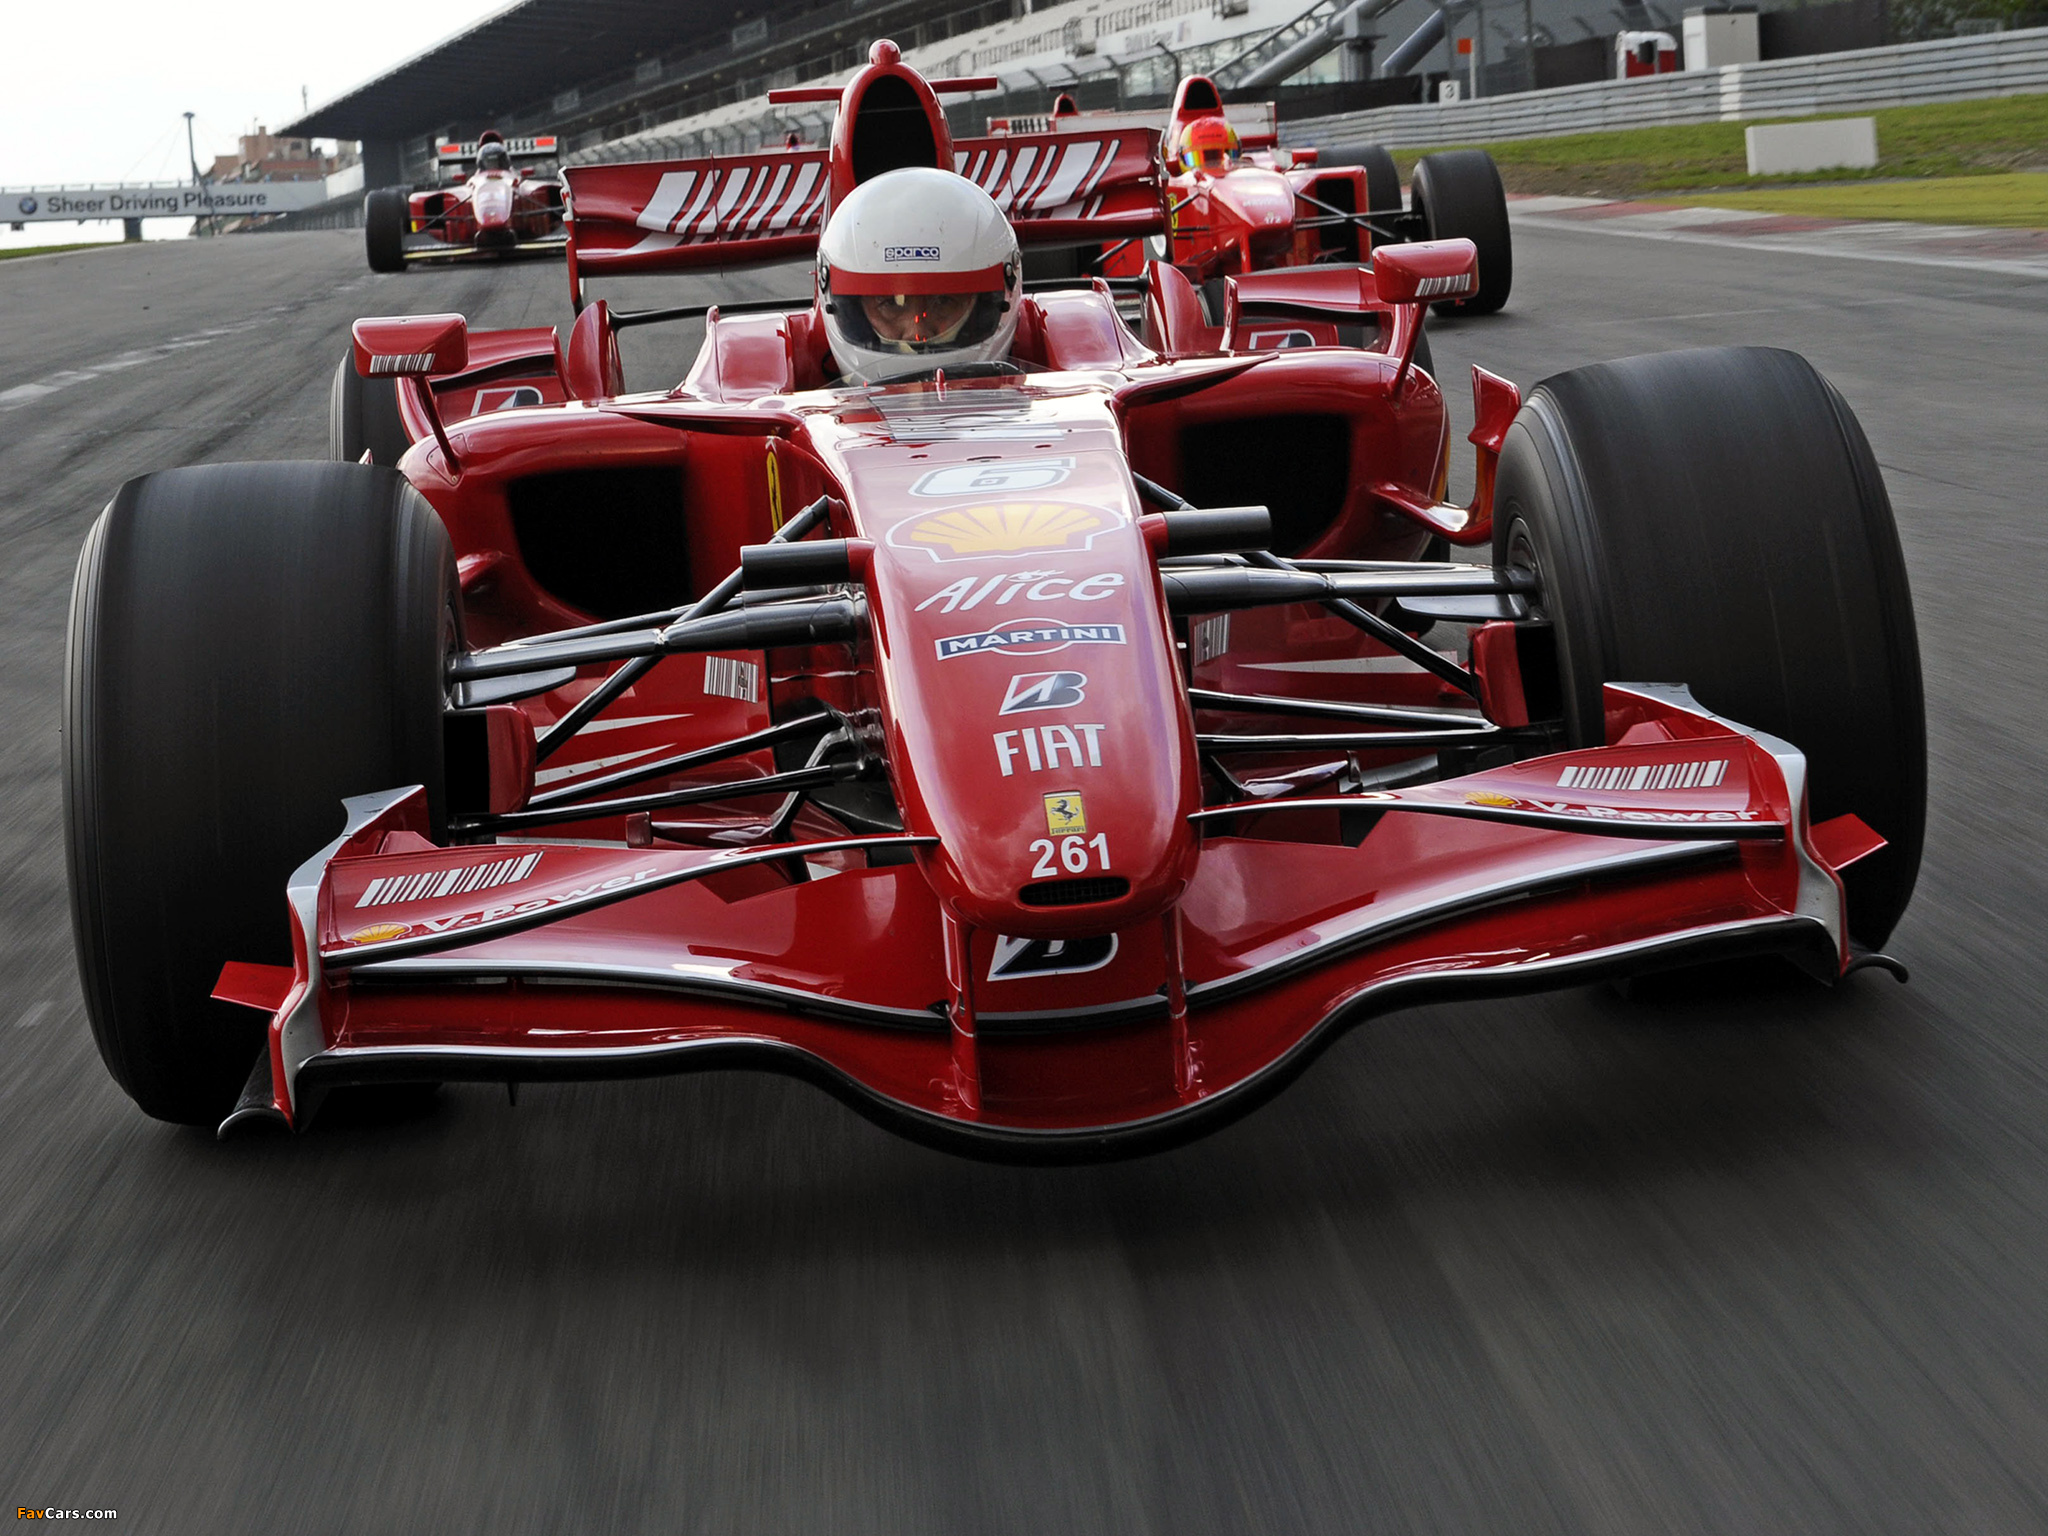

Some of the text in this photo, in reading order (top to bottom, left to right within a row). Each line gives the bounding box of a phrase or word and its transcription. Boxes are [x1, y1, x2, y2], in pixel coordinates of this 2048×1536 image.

[47, 191, 267, 213] Sheer Driving Pleasure
[885, 246, 940, 261] sparco
[914, 569, 1125, 614] Alice
[949, 626, 1111, 653] MARTINI
[993, 724, 1106, 777] FIAT
[1527, 799, 1759, 822] V-Power
[1029, 832, 1111, 878] 261
[422, 867, 658, 933] V-Power
